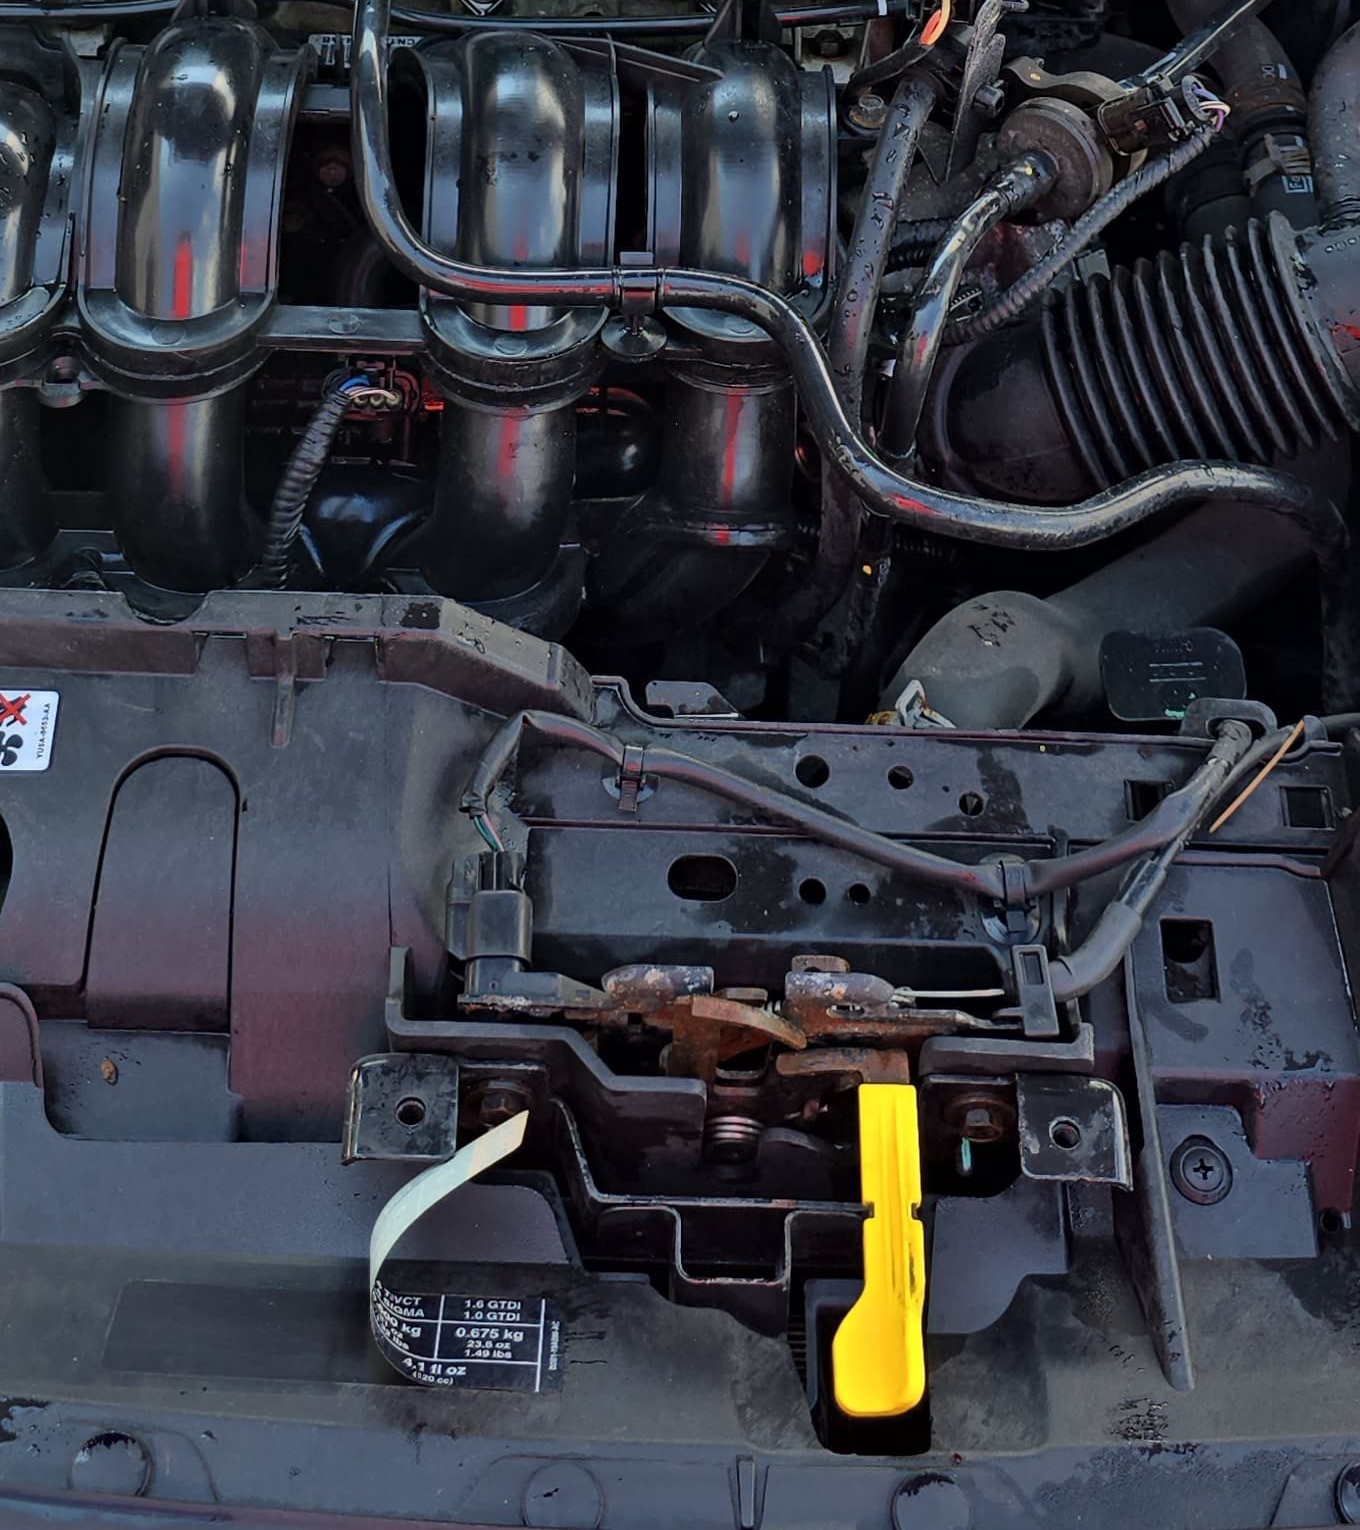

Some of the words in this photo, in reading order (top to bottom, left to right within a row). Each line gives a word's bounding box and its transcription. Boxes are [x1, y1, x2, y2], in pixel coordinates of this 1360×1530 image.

[464, 1299, 485, 1310] 1.6
[487, 1300, 521, 1311] GTDI
[463, 1311, 483, 1320] 1.0
[486, 1312, 520, 1322] GTDI
[455, 1327, 500, 1340] 0.675
[503, 1328, 524, 1342] kg
[495, 1341, 512, 1350] oz
[464, 1348, 490, 1358] 1.49
[446, 1365, 467, 1375] oz
